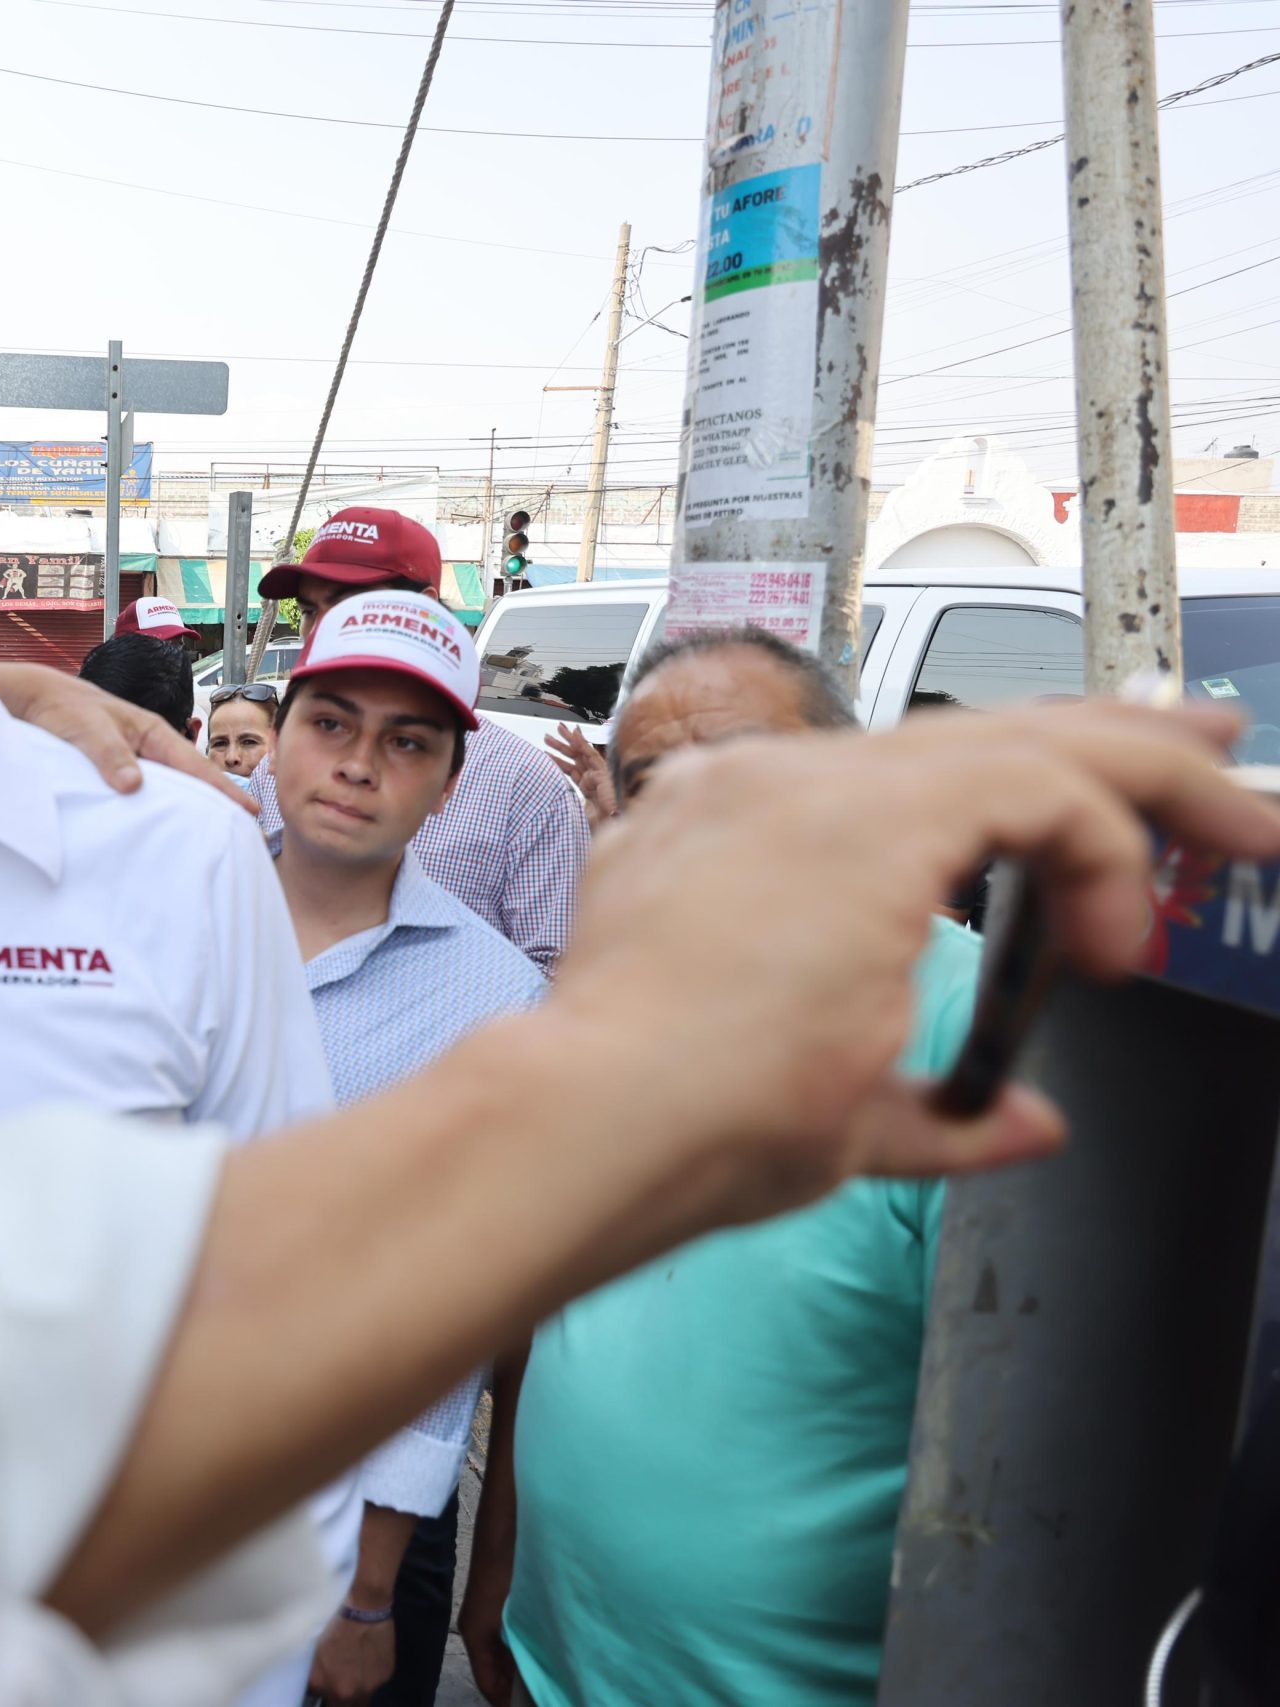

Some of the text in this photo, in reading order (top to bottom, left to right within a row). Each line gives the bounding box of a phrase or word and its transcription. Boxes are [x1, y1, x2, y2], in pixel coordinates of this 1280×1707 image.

[715, 186, 786, 221] TU AFORE
[702, 427, 751, 441] WHATSAPP
[39, 458, 108, 468] CUÑAD
[17, 467, 43, 476] DE
[693, 498, 730, 509] PREGUNTA
[732, 496, 750, 504] POR
[753, 491, 803, 503] NUESTRAS
[713, 508, 744, 518] RETIRO
[25, 554, 82, 565] Yamil
[362, 603, 417, 615] morena
[341, 613, 461, 663] ARMENTA
